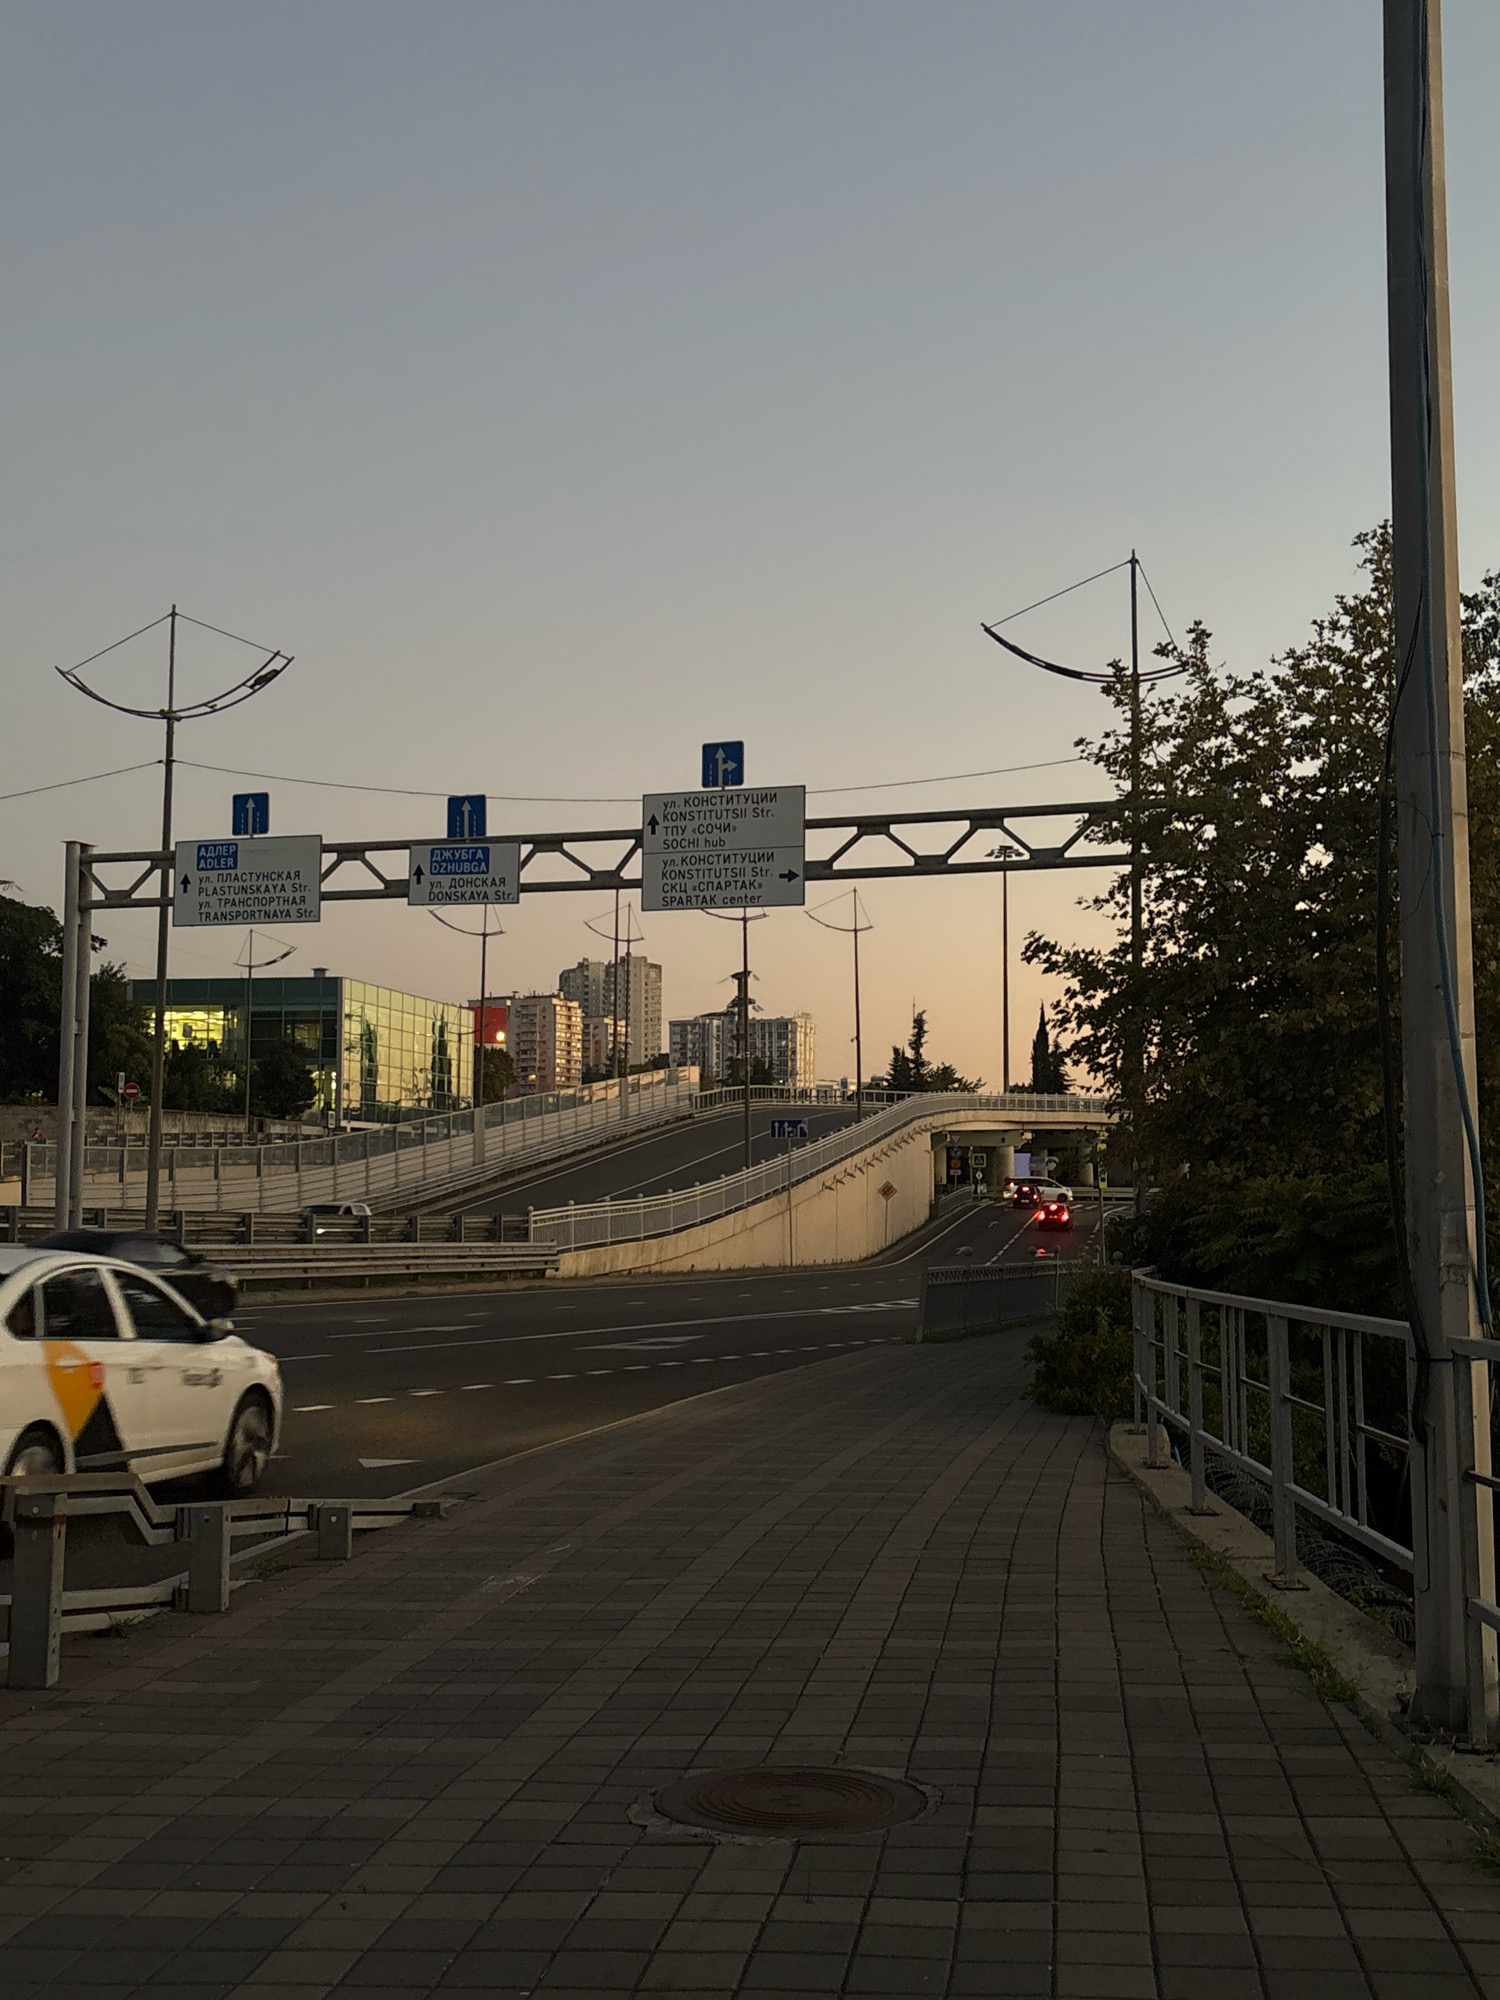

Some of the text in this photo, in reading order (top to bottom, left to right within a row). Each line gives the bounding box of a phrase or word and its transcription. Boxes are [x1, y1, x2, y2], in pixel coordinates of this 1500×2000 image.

[663, 792, 778, 812] ул. КОНСТИТУЦИИ
[663, 807, 775, 823] KONSTITUTSII Str.
[663, 823, 737, 837] ТПУ «СОЧИ»
[663, 836, 726, 850] SOCHI hub
[199, 845, 237, 858] АДЛЕР
[432, 849, 484, 862] ДЖУБГА
[199, 858, 235, 869] ADLER
[431, 861, 487, 873] DZHUBGA
[662, 851, 775, 870] ул. КОНСТИТУЦИИ
[198, 870, 301, 886] ул. ПЛАСТУНСКАЯ
[661, 866, 773, 881] KONSTITUTSII Str.
[198, 882, 312, 897] PLASTUNSKAYA Str.
[429, 877, 506, 890] ул. ДОНСКАЯ
[661, 879, 763, 894] СКЦ «СПАРТАК»
[428, 890, 515, 902] DONSKAYA Str.
[661, 893, 762, 907] SPARTAK center
[198, 896, 306, 911] ул. ТРАНСПОРТНАЯ
[198, 908, 317, 922] TRANSPORTNAYA Str.
